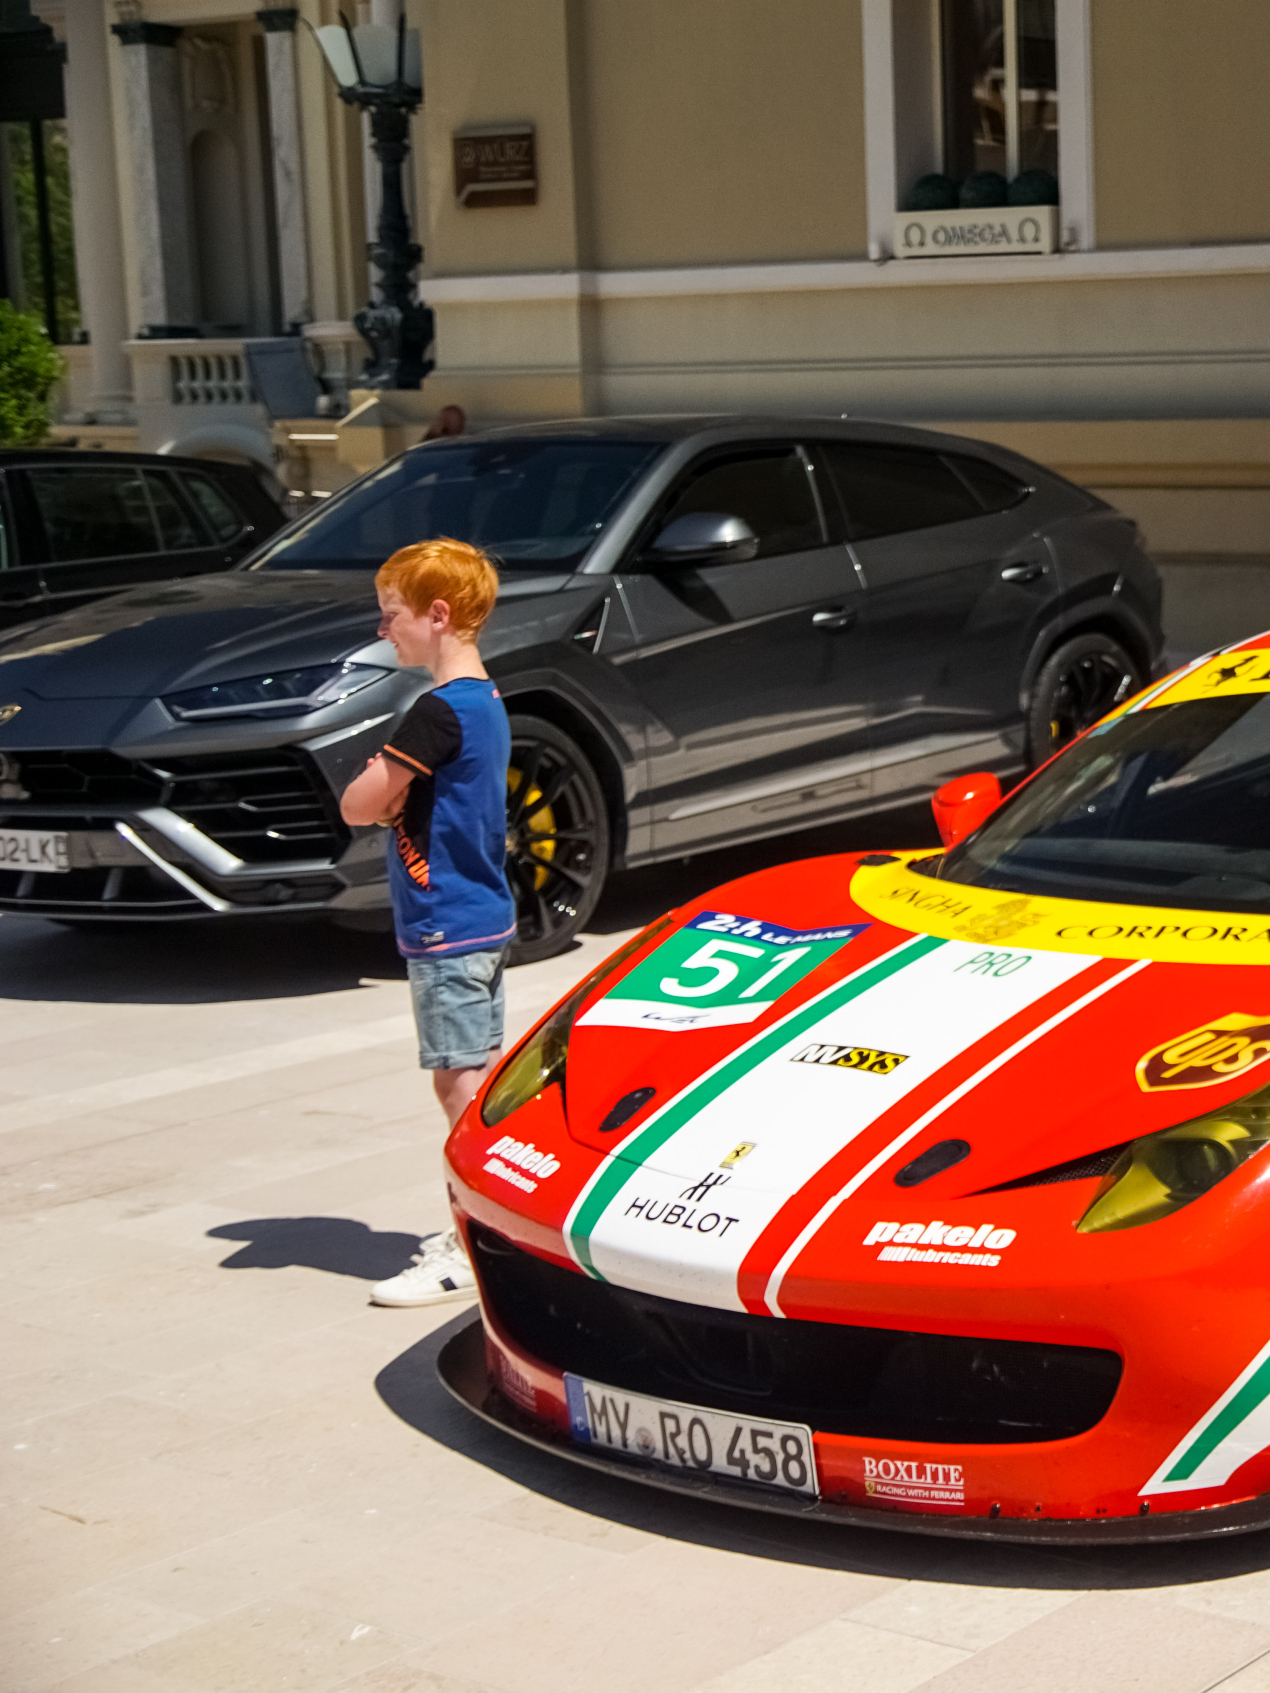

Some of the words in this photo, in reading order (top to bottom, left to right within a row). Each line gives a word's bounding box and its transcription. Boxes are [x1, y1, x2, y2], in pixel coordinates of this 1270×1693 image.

[931, 223, 1012, 246] OMEGA
[659, 938, 812, 998] 51
[953, 951, 1032, 978] PRO
[485, 1135, 561, 1179] pakelo
[623, 1197, 740, 1238] HUBLOT
[862, 1220, 1017, 1249] pakelo
[900, 1247, 1001, 1267] lubricants
[585, 1391, 630, 1450] MY
[659, 1411, 713, 1472] RO
[726, 1426, 808, 1487] 458
[862, 1457, 964, 1486] BOXLITE
[876, 1484, 906, 1496] RACING
[906, 1488, 929, 1498] WITH
[930, 1490, 965, 1500] FERRARI
